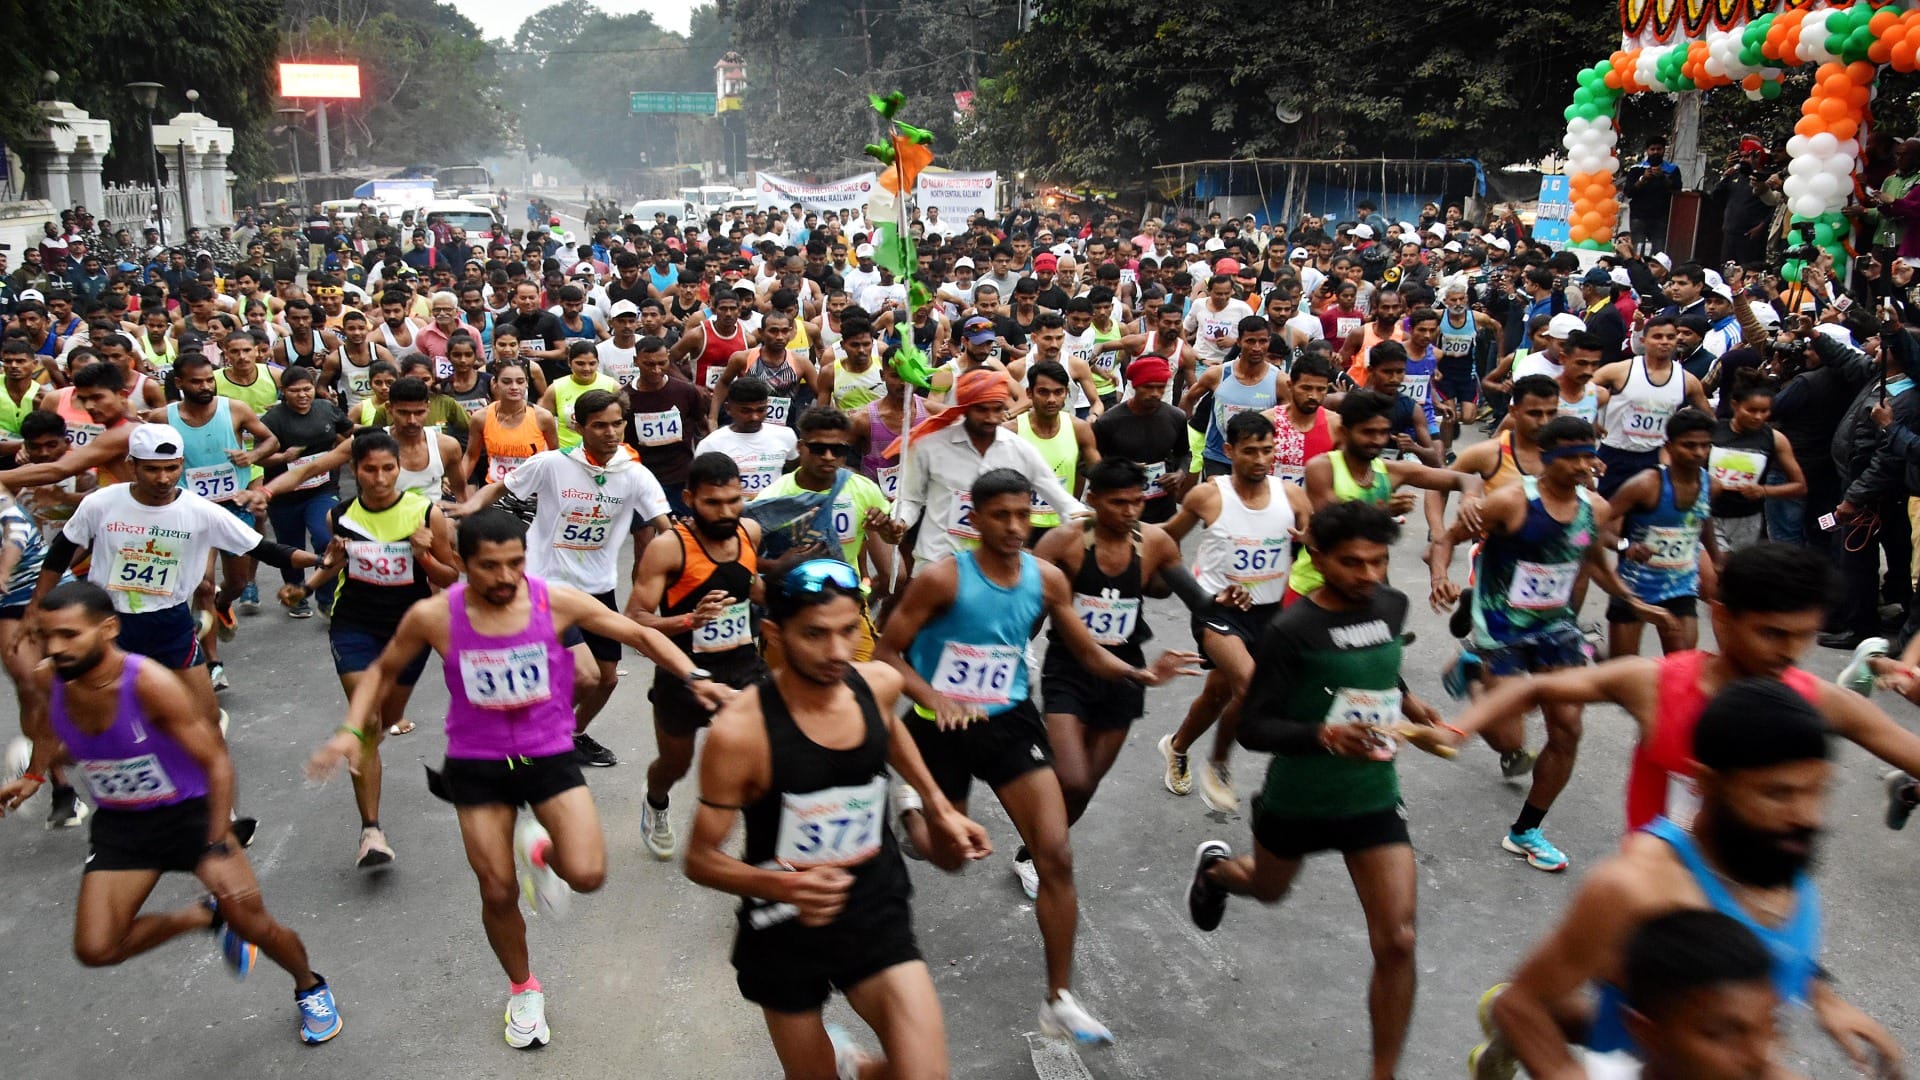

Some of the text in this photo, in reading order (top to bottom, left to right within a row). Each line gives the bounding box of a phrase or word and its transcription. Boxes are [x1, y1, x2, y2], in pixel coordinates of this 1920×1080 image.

[775, 182, 859, 194] RAILWAY PROTECTION FORCE
[778, 193, 799, 202] NORTH
[828, 194, 856, 202] RAILWAY
[1445, 342, 1468, 352] 209
[642, 420, 678, 438] 514
[1630, 414, 1663, 430] 301
[195, 476, 234, 497] 375
[740, 474, 772, 489] 533
[563, 524, 605, 542] 543
[1233, 548, 1282, 570] 367
[120, 562, 168, 586] 541
[704, 616, 746, 640] 539
[476, 664, 540, 697] 319
[948, 660, 1008, 689] 316
